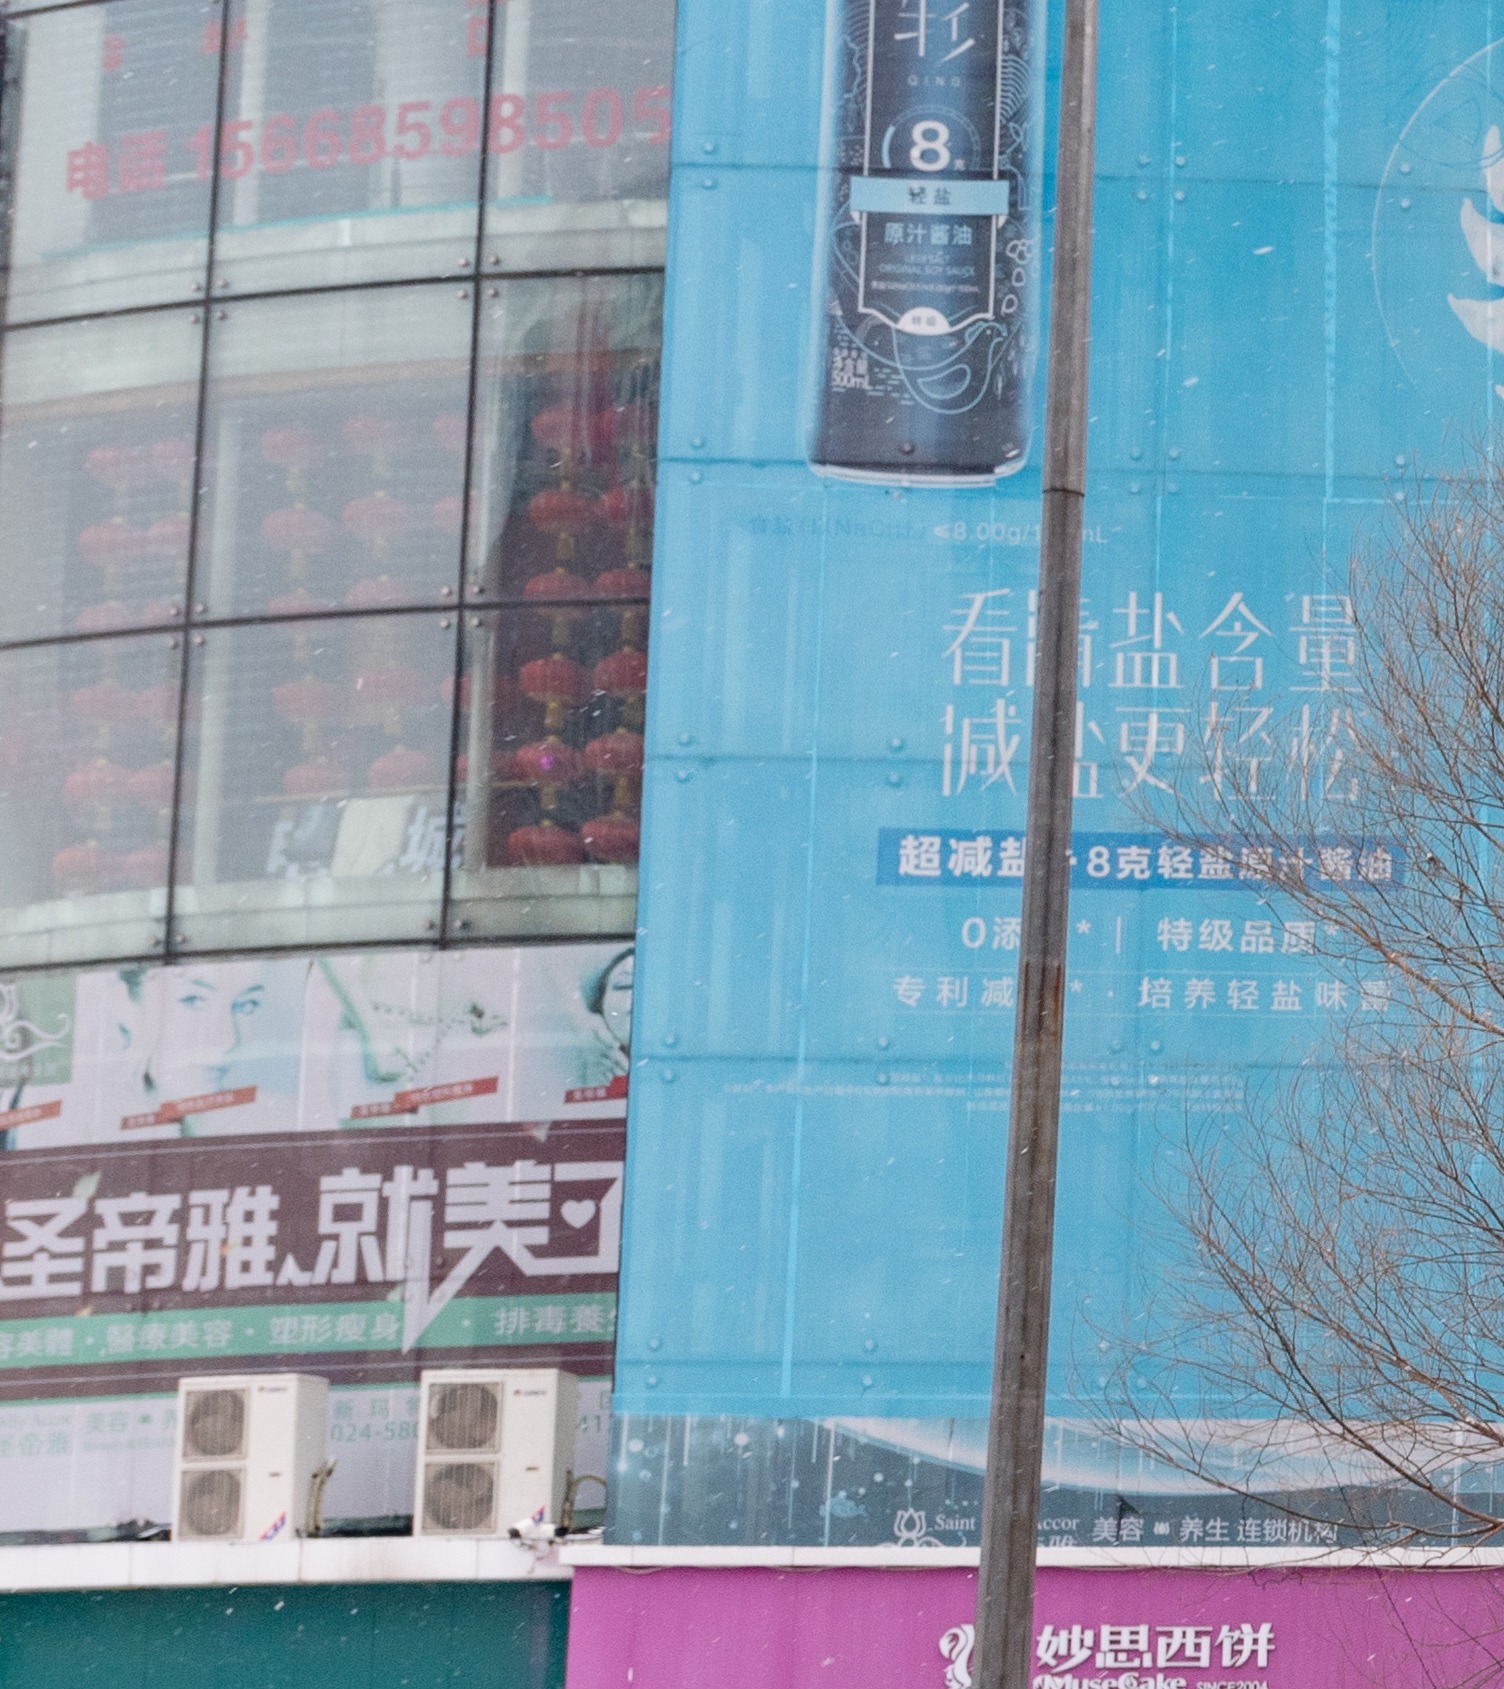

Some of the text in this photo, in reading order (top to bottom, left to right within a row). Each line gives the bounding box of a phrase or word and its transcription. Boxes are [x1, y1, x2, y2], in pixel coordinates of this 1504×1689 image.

[934, 1513, 1080, 1531] Saint ccor
[1092, 1516, 1144, 1543] 美容
[1179, 1516, 1231, 1543] 养生
[1036, 1622, 1276, 1674] 妙思西饼
